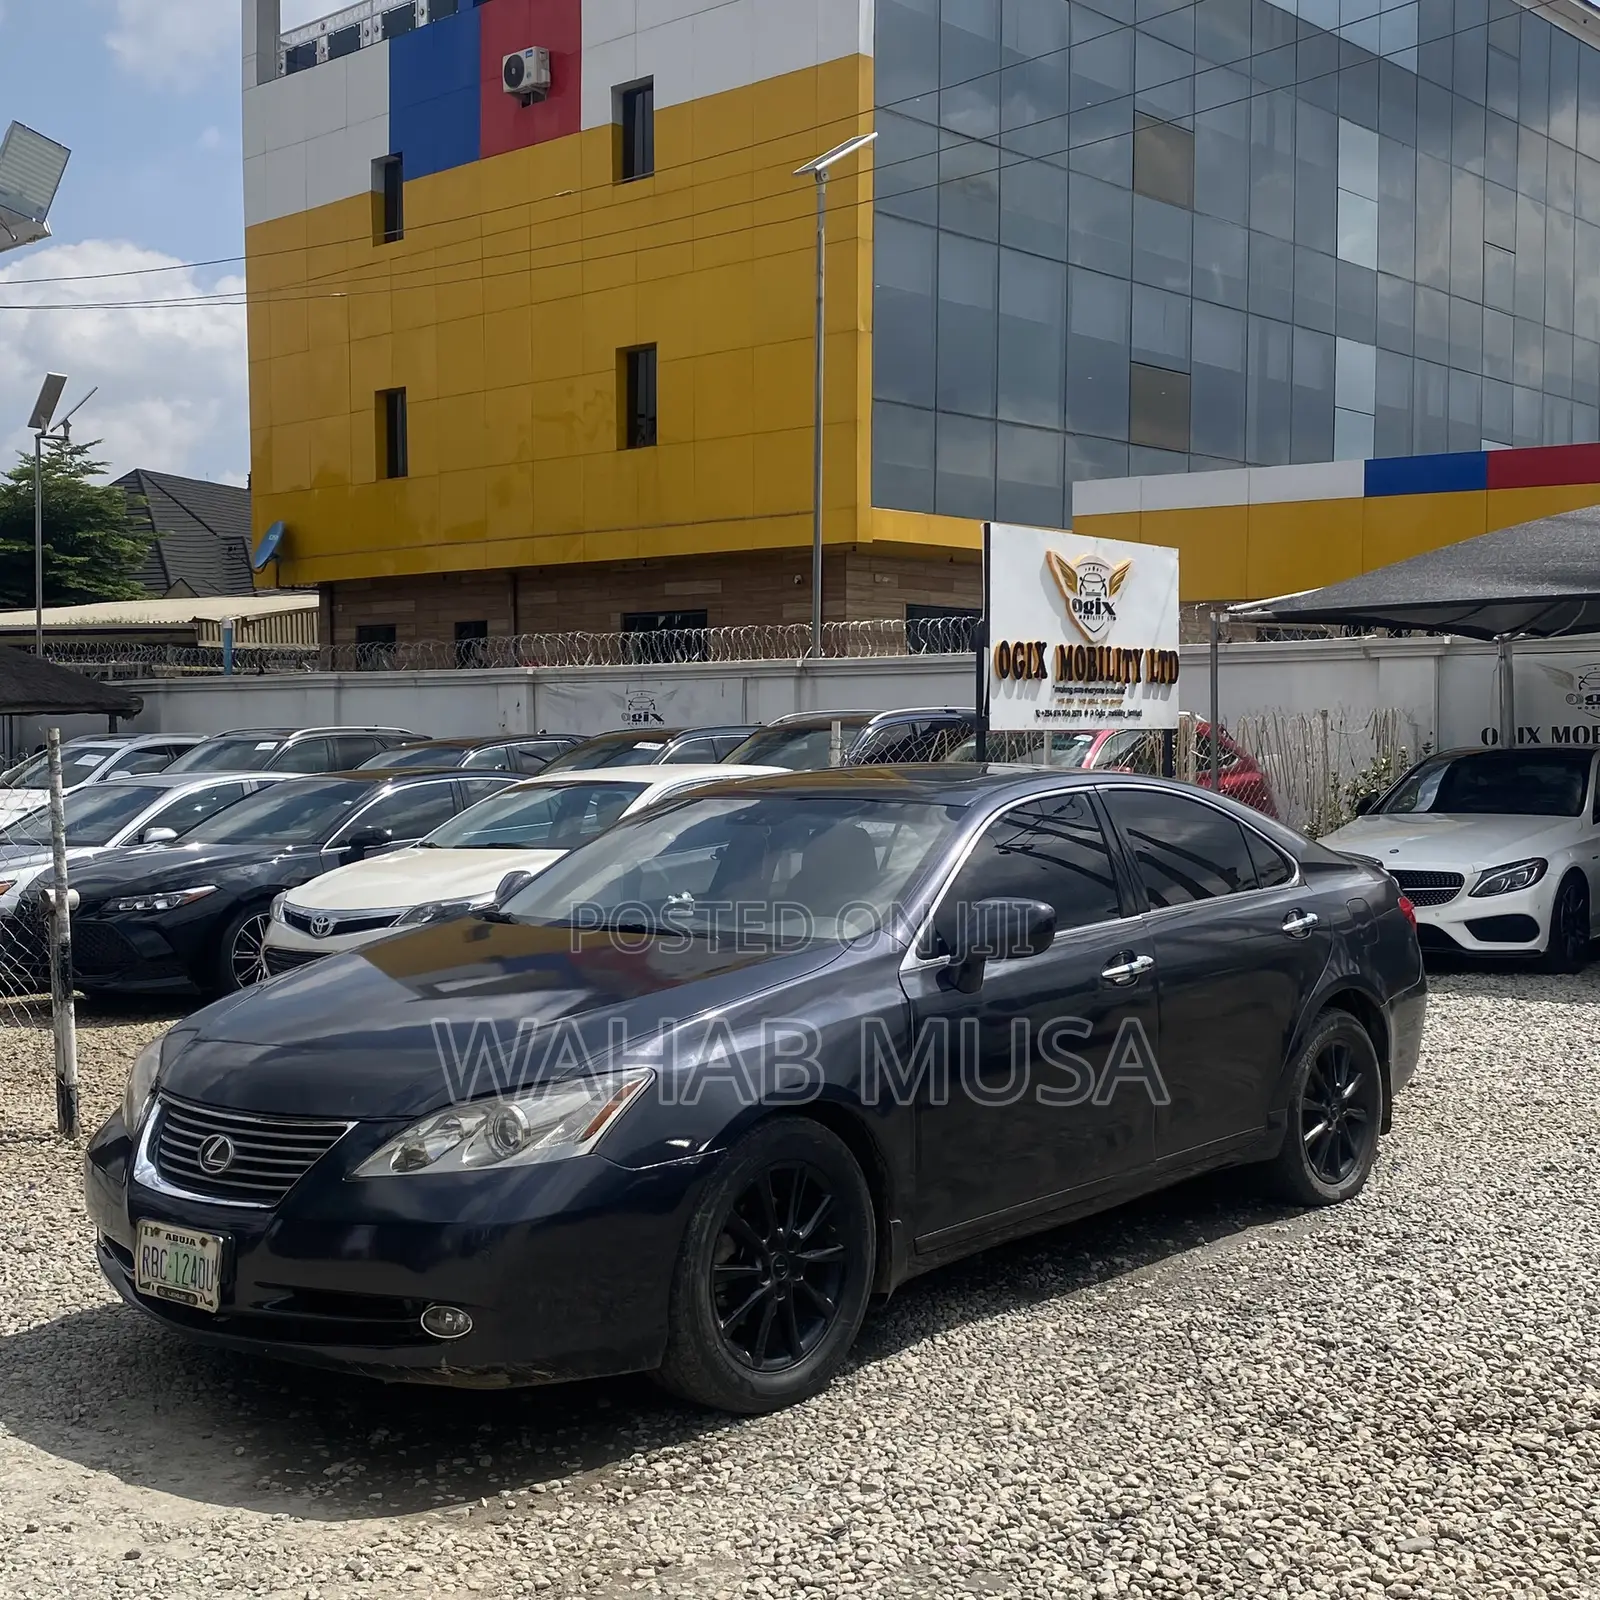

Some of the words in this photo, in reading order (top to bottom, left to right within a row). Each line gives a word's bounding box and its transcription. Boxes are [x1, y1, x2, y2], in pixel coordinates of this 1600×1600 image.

[994, 640, 1048, 680] OGIX
[1055, 644, 1143, 684] MOBILITY
[1145, 648, 1180, 684] LTD
[1481, 726, 1541, 746] OIX
[165, 1233, 196, 1246] ABUJA
